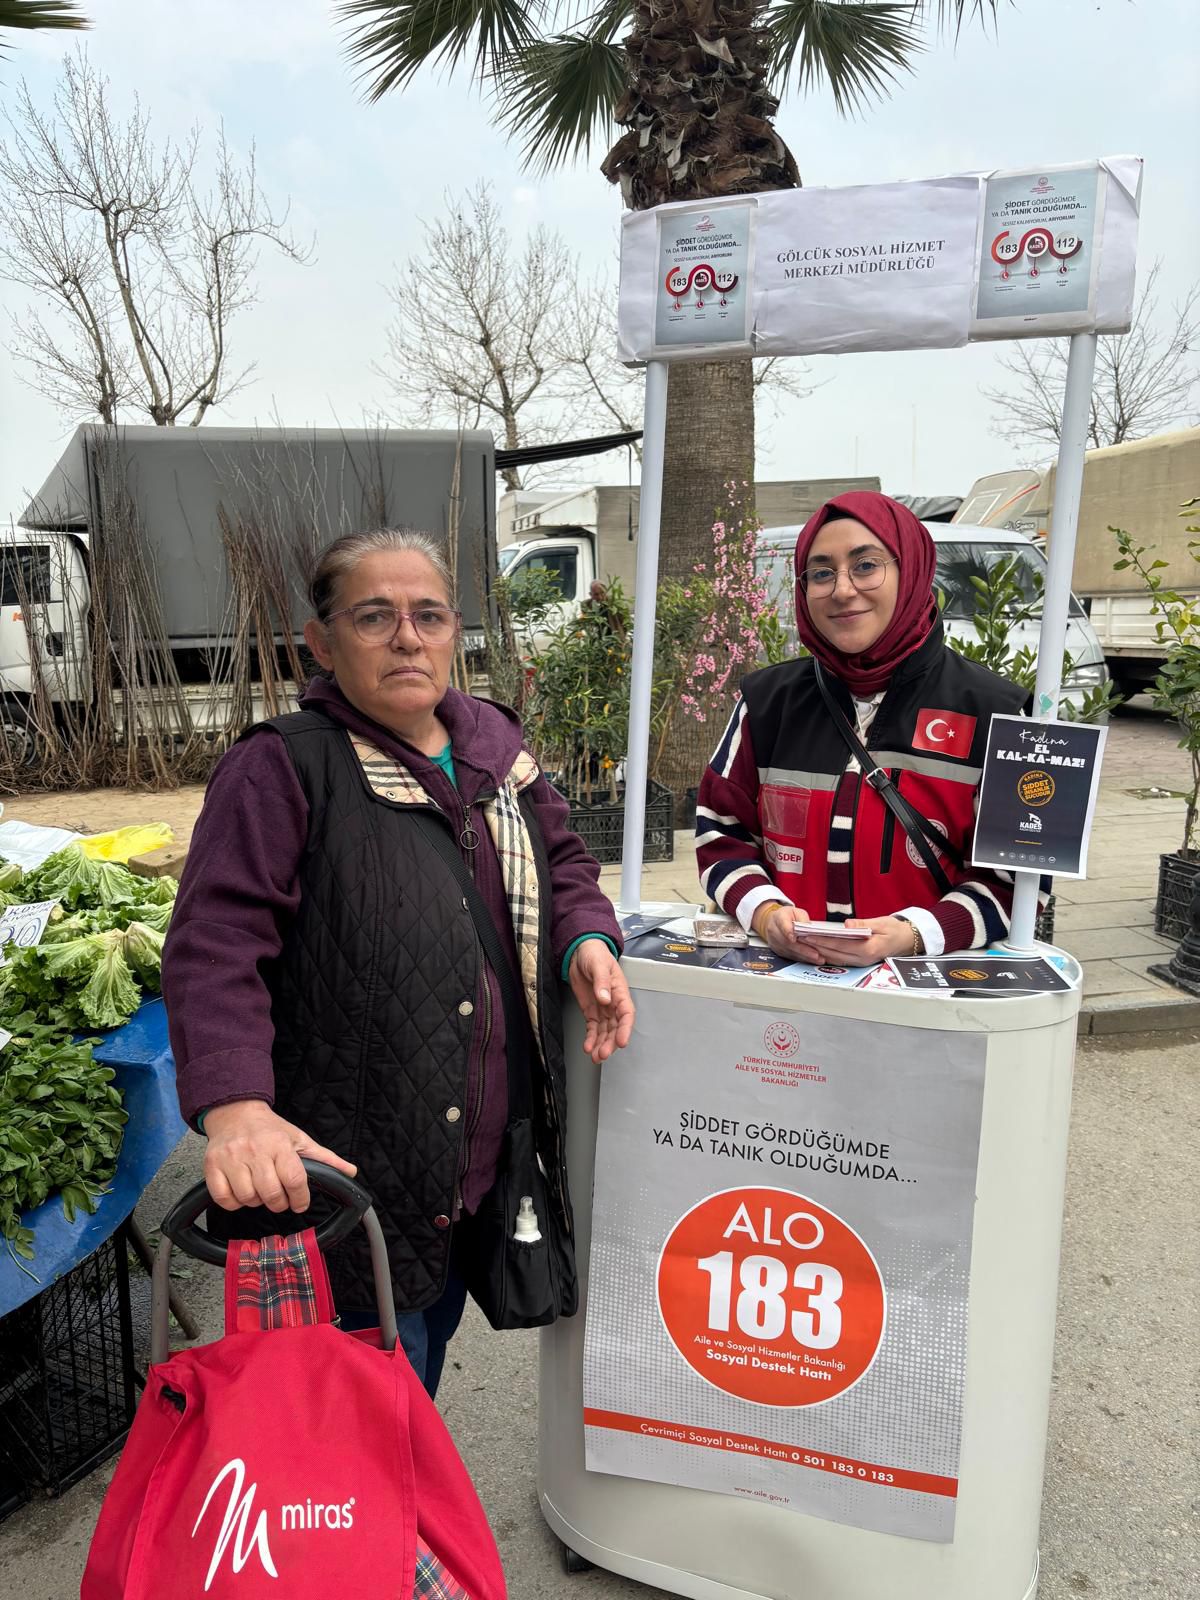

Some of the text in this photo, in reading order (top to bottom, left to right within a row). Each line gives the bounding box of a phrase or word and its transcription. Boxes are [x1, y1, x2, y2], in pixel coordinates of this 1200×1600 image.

[1004, 200, 1030, 210] ŞİDDET
[777, 240, 946, 263] GÖLCÜK SOSYAL HİZMET
[1000, 244, 1018, 253] 183
[1056, 238, 1074, 248] 112
[784, 256, 935, 279] MERKEZİ MÜDÜRLÜĞÜ
[672, 278, 686, 286] 183
[717, 274, 732, 282] 112
[1034, 744, 1050, 754] EL
[996, 750, 1085, 768] KAL-KA-MAZ!
[1020, 822, 1042, 830] KADES
[803, 970, 841, 980] KADES
[743, 1056, 820, 1072] TÜRKİYE CUMHURİYETİ
[761, 1067, 786, 1076] SOSYAL
[788, 1071, 826, 1083] HİZMETLER
[762, 1077, 799, 1087] BAKANLIĞI
[679, 1110, 890, 1160] ŞİDDET GÖRDÜĞÜMDE
[653, 1129, 918, 1184] YA DA TANIK OLDUĞUMDA...
[723, 1202, 824, 1250] ALO
[698, 1250, 843, 1350] 183
[694, 1335, 846, 1372] Aile ve Sosyal Hizmetler Bakanlığı
[706, 1349, 832, 1381] Sosyal Destek Hattı
[640, 1424, 894, 1482] Çevrimiçi Sosyal Destek Hattı 0 501 183 0 183
[734, 1487, 790, 1504] www.aile.gov.tr
